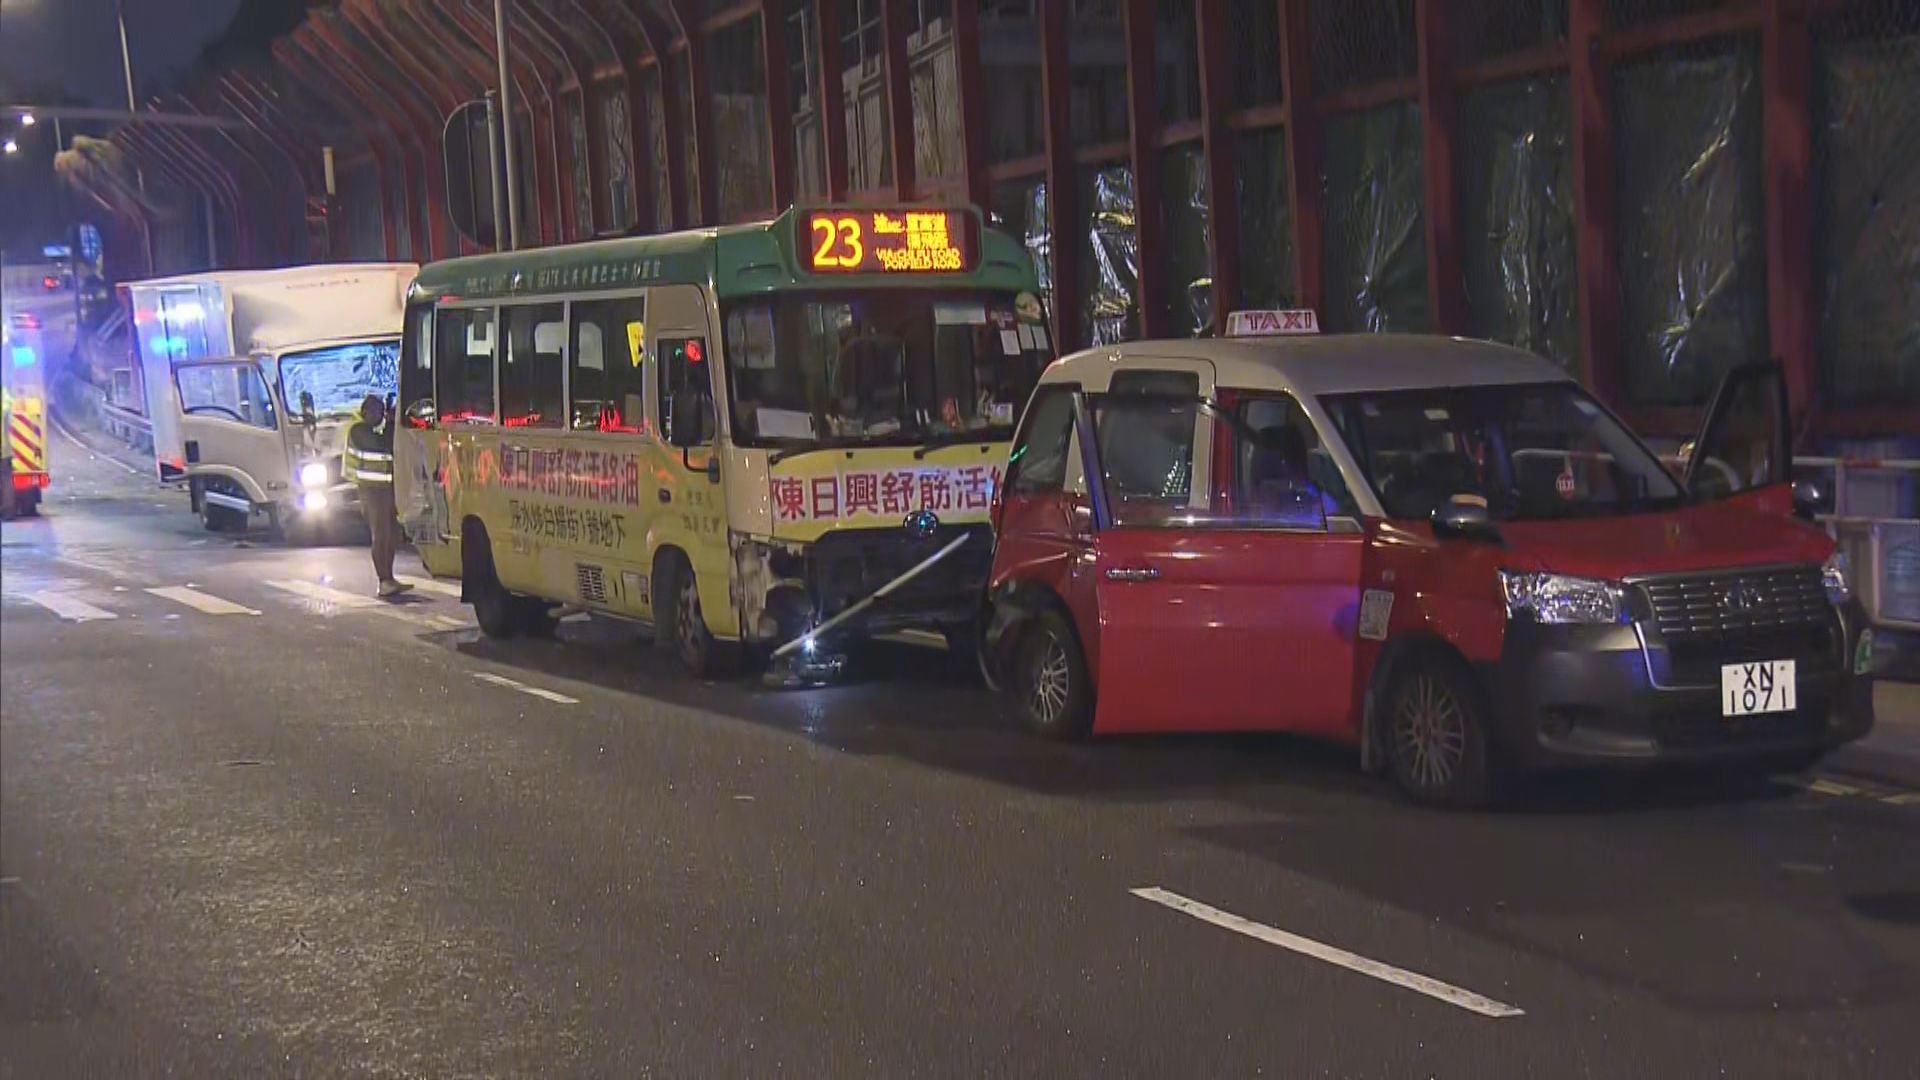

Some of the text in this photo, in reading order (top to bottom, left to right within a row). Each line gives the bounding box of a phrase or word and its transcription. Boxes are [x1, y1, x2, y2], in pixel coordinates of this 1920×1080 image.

[812, 217, 864, 268] 23
[1244, 311, 1312, 331] TAXI
[1743, 661, 1775, 688] XN
[1730, 686, 1787, 714] 1071
